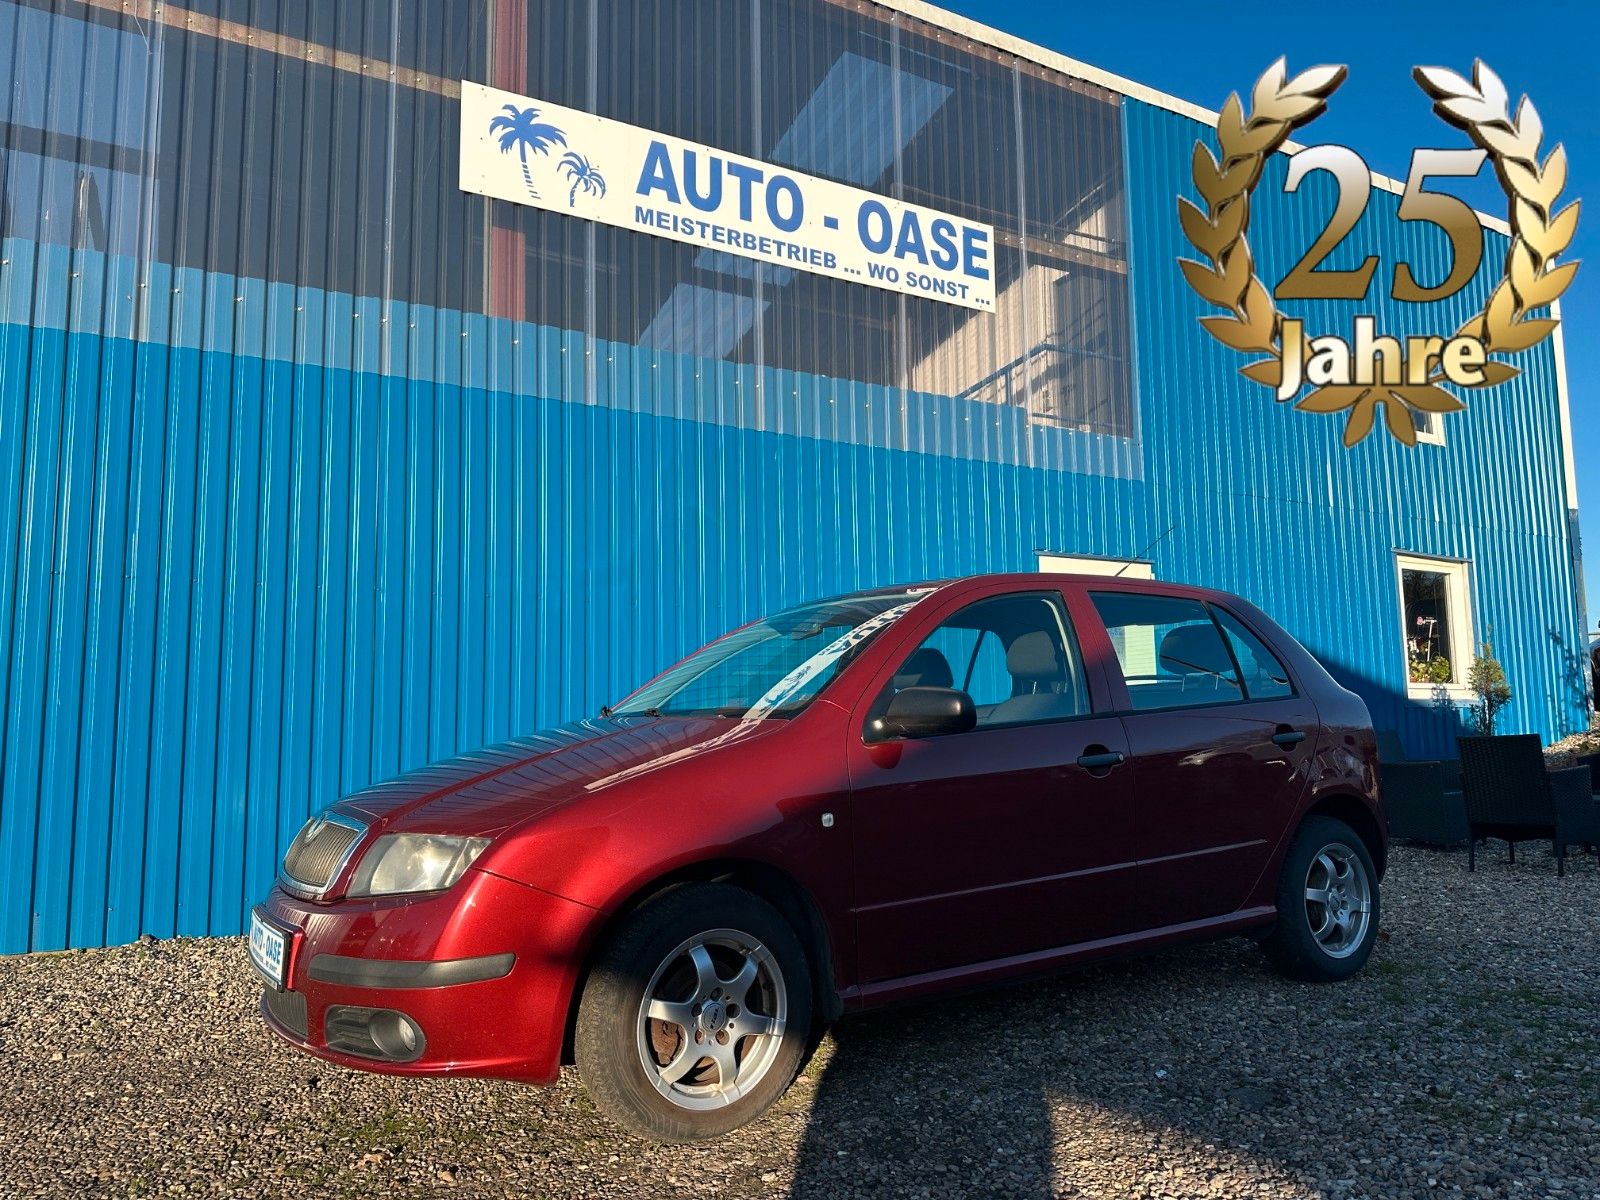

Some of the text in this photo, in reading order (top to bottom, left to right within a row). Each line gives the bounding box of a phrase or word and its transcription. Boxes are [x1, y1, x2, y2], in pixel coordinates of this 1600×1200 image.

[634, 205, 837, 269] MEISTERBETRIEB
[867, 262, 900, 283] WO
[906, 271, 969, 299] SONST
[635, 140, 804, 233] AUTO
[857, 199, 990, 280] OASE
[266, 935, 282, 965] OASE
